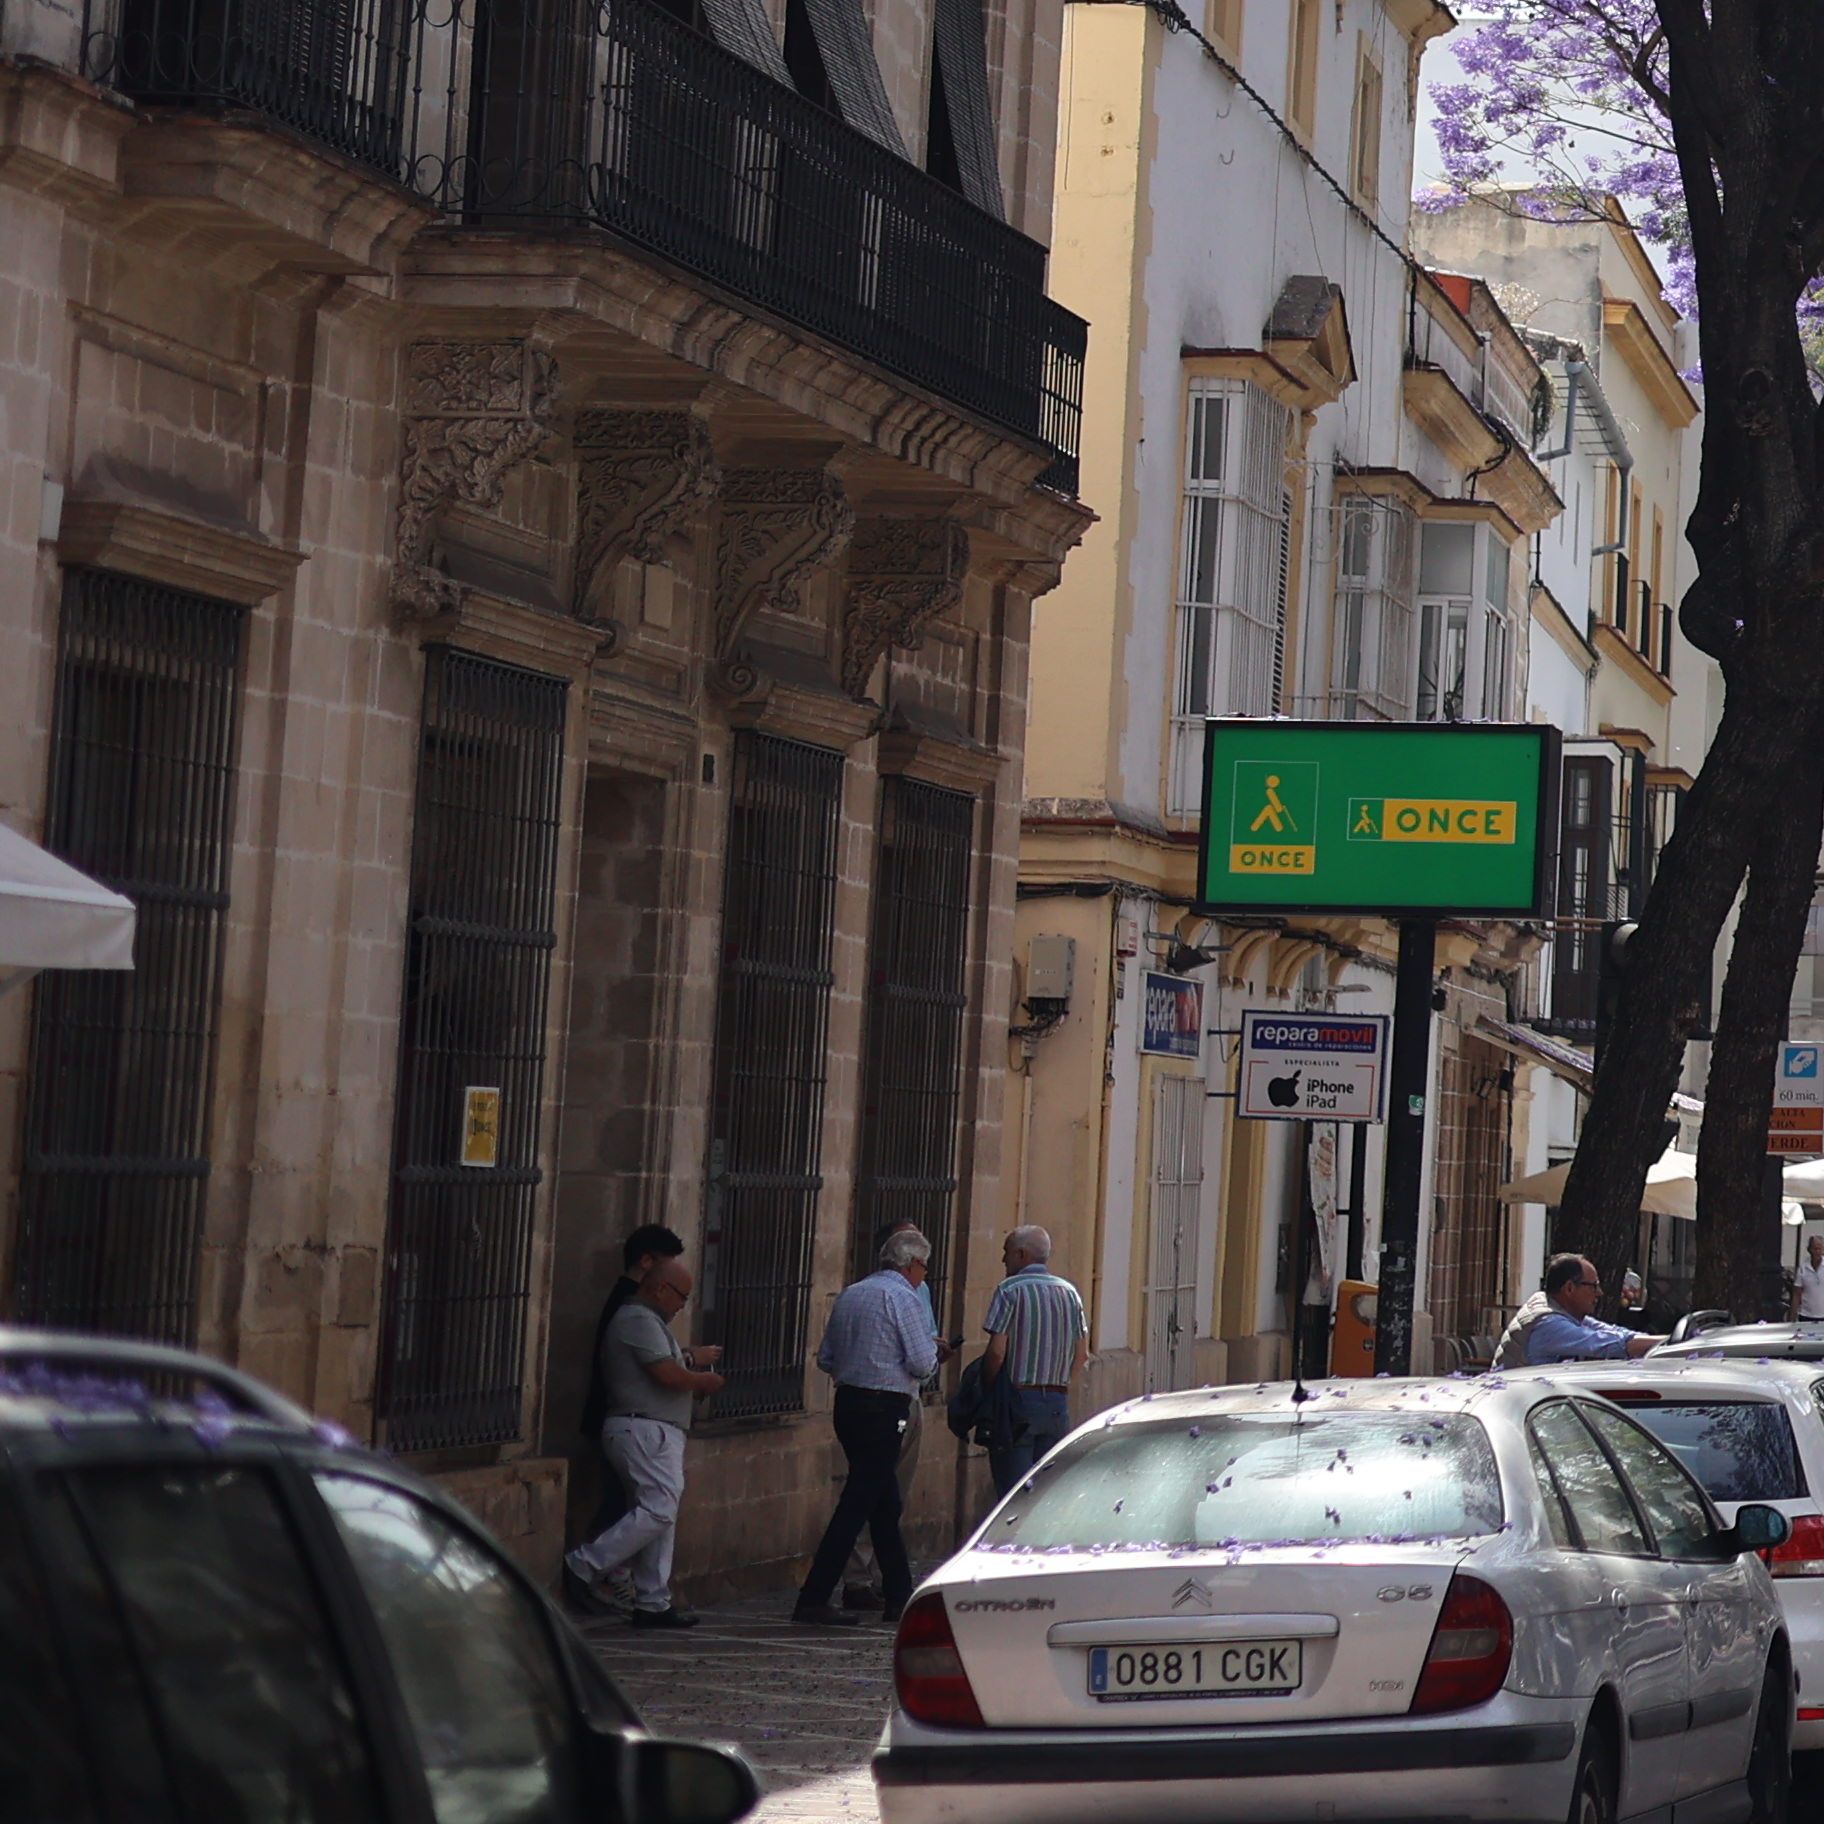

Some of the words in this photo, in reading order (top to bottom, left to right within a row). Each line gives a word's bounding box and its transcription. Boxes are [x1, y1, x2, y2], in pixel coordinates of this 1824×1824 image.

[1396, 807, 1503, 835] ONCE
[1240, 850, 1306, 869] ONCE
[1256, 1026, 1374, 1045] reparamovil
[1284, 1059, 1341, 1067] ESPECIALISTA
[1306, 1078, 1355, 1095] iPhone
[1306, 1094, 1337, 1109] iPad
[1779, 1090, 1794, 1102] 60
[1771, 1137, 1809, 1149] ERDE
[1115, 1649, 1203, 1686] 0881
[1221, 1647, 1289, 1683] CGK
